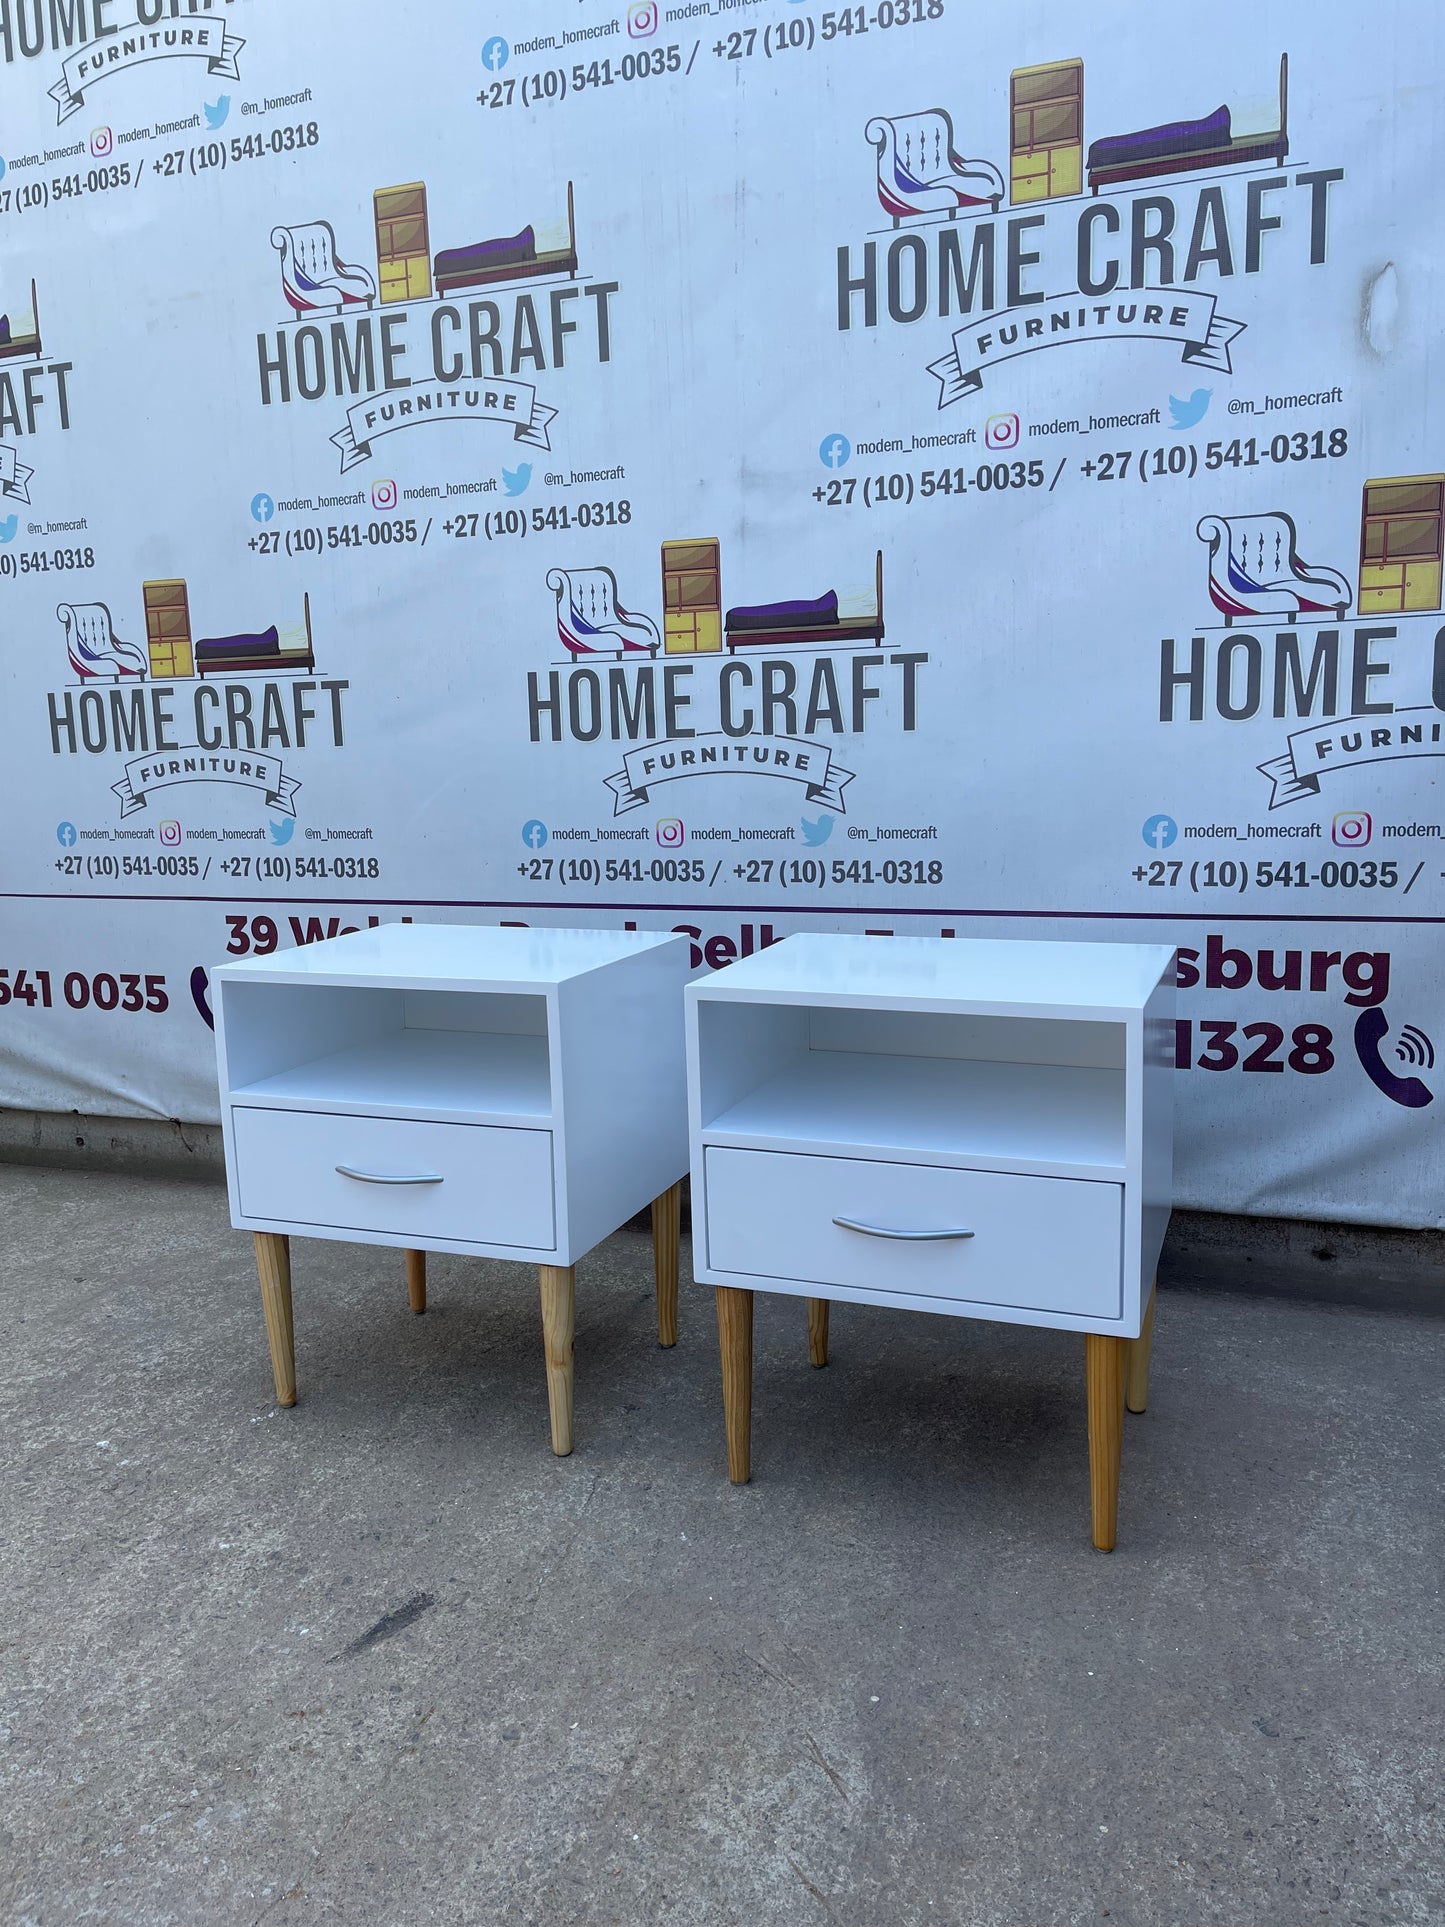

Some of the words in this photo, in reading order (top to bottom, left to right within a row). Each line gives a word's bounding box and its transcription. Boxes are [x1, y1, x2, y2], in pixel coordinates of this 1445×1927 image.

[78, 30, 209, 78] FURNITURE
[476, 79, 516, 109] +27
[521, 69, 567, 107] (10)
[572, 45, 681, 92] 541-0035
[686, 40, 700, 75] /
[712, 28, 757, 60] +27
[764, 17, 815, 58] (10)
[822, 0, 945, 40] 541-0318
[240, 88, 312, 116] @m_homecraft
[15, 182, 48, 213] (10)
[52, 163, 131, 200] 541-0035
[134, 159, 144, 188] /
[153, 150, 184, 177] +27
[189, 141, 227, 176] (10)
[230, 121, 320, 162] 541-0318
[837, 215, 1045, 331] HOME
[1076, 168, 1344, 297] CRAFT
[257, 313, 412, 405] HOME
[430, 281, 619, 383] CRAFT
[976, 305, 1189, 355] FURNITURE
[365, 390, 517, 428] FURNITURE
[1227, 387, 1343, 416] @m_homecraft
[544, 465, 625, 487] @m_homecraft
[811, 476, 857, 507] +27
[863, 470, 914, 508] (10)
[920, 460, 1044, 498] 541-0035
[1050, 458, 1067, 491] /
[1080, 450, 1132, 482] +27
[1139, 445, 1198, 484] (10)
[1204, 428, 1349, 470] 541-0318
[28, 518, 88, 535] @m_homecraft
[247, 531, 280, 554] +27
[285, 527, 323, 556] (10)
[327, 519, 417, 548] 541-0035
[421, 518, 432, 545] /
[442, 513, 479, 539] +27
[484, 509, 527, 541] (10)
[531, 500, 632, 532] 541-0318
[20, 547, 95, 574] 541-0318
[1159, 626, 1397, 722] HOME
[527, 664, 695, 742] HOME
[719, 652, 928, 738] CRAFT
[47, 687, 179, 754] HOME
[194, 680, 349, 750] CRAFT
[140, 757, 267, 782] FURNITURE
[643, 745, 810, 775] FURNITURE
[305, 828, 373, 841] @m_homecraft
[847, 825, 937, 842] @m_homecraft
[55, 856, 83, 875] +27
[87, 856, 119, 879] (10)
[122, 856, 199, 876] 541-0035
[202, 857, 212, 880] /
[220, 857, 252, 877] +27
[256, 857, 291, 881] (10)
[295, 857, 380, 878] 541-0318
[517, 859, 554, 881] +27
[559, 859, 600, 885] (10)
[605, 859, 704, 883] 541-0035
[709, 860, 722, 887] /
[733, 860, 774, 883] +27
[780, 859, 826, 888] (10)
[831, 860, 943, 885] 541-0318
[1132, 861, 1183, 887] +27
[1190, 861, 1248, 893] (10)
[1256, 861, 1398, 889] 541-0035
[1403, 861, 1425, 894] /
[225, 915, 279, 956] 39
[63, 971, 169, 1013] 0035
